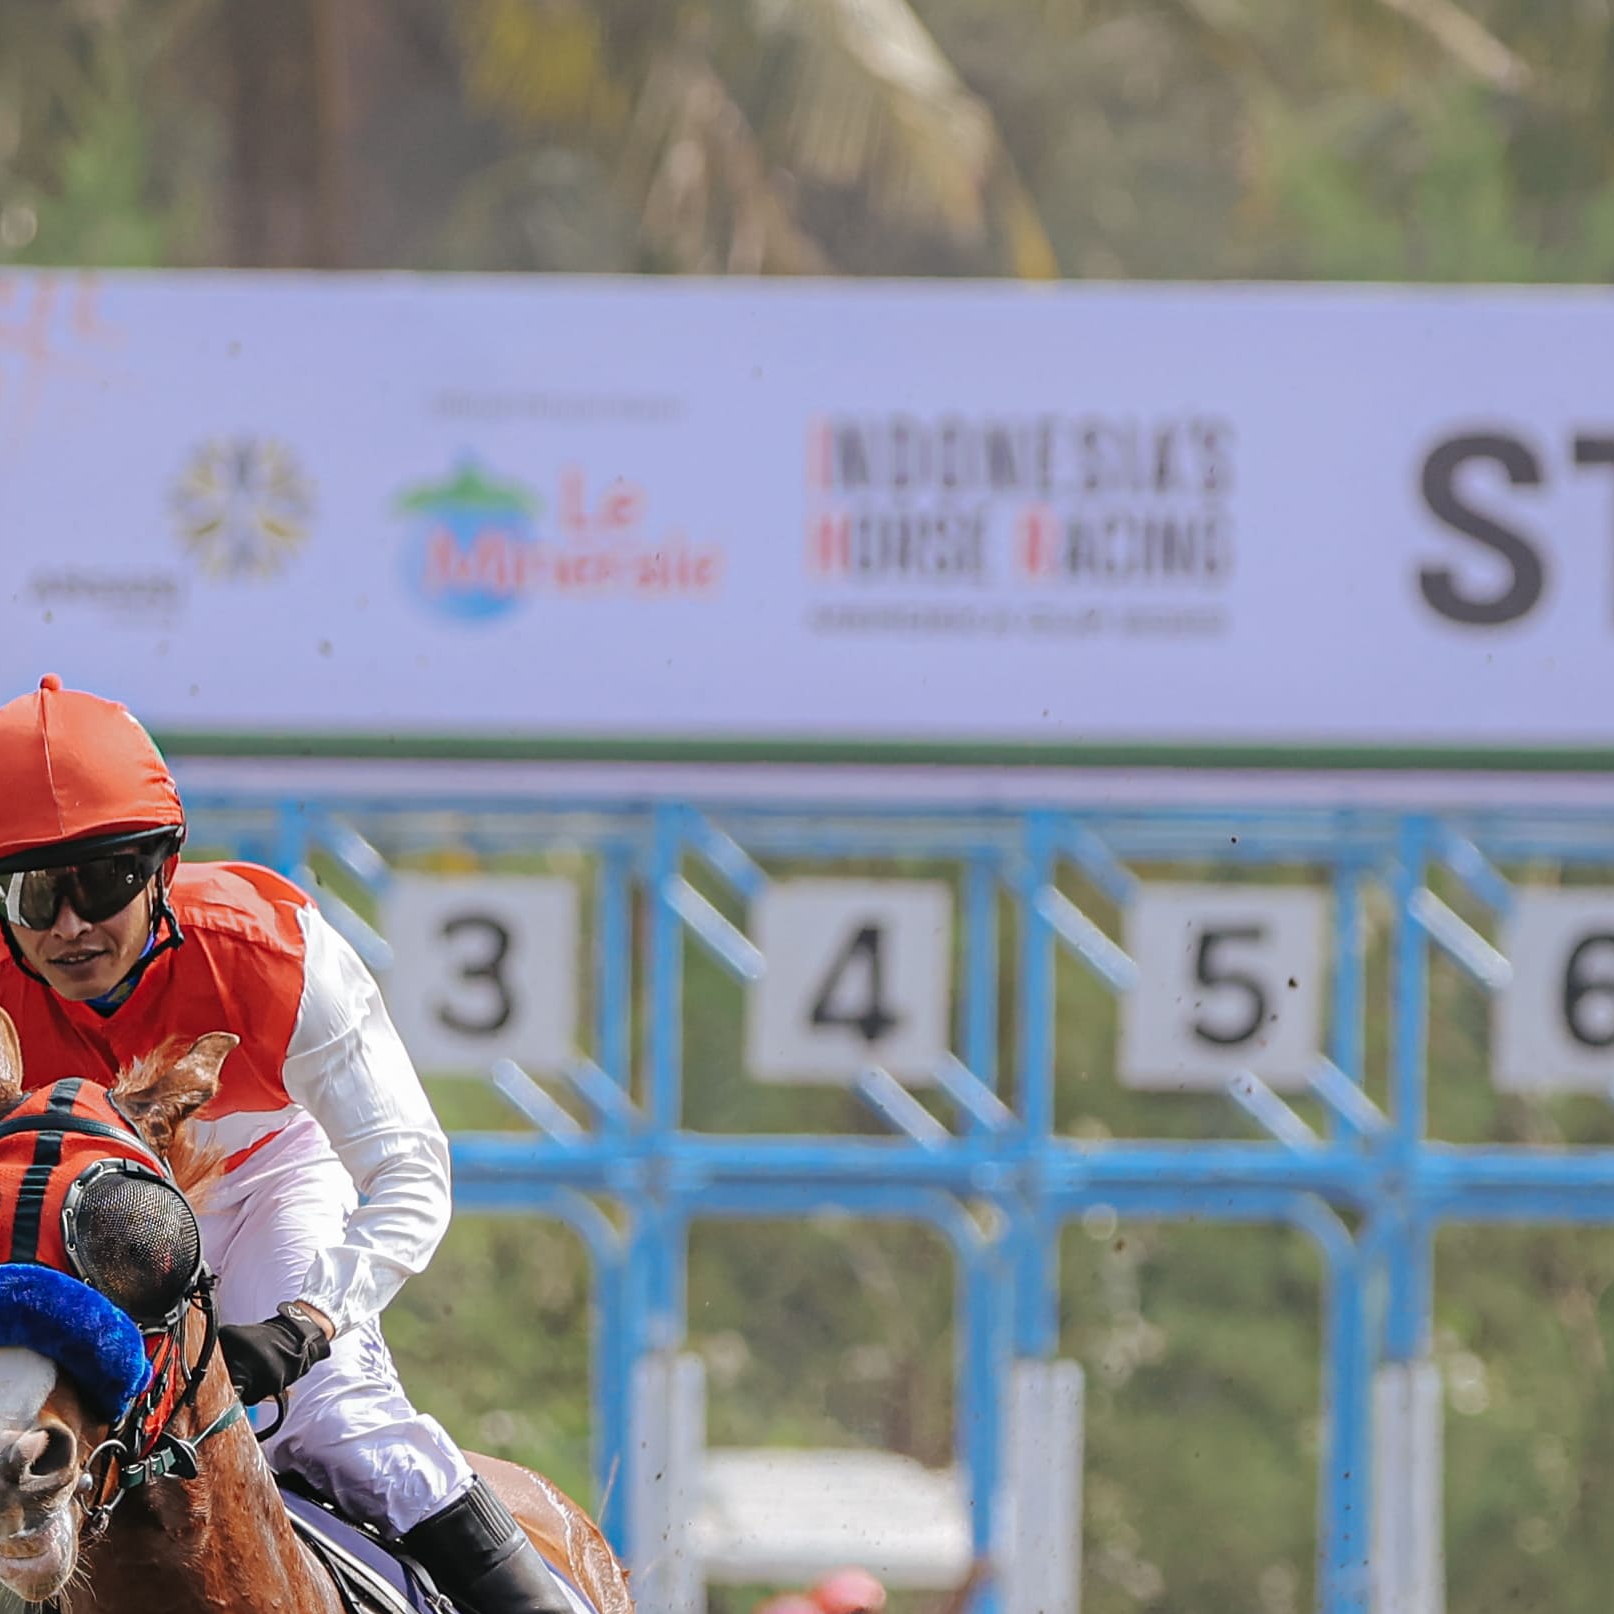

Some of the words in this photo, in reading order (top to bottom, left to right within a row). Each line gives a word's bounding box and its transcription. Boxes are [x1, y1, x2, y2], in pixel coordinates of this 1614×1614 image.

[440, 915, 513, 1035] 3
[809, 923, 898, 1043] 4
[1192, 926, 1269, 1050] 5
